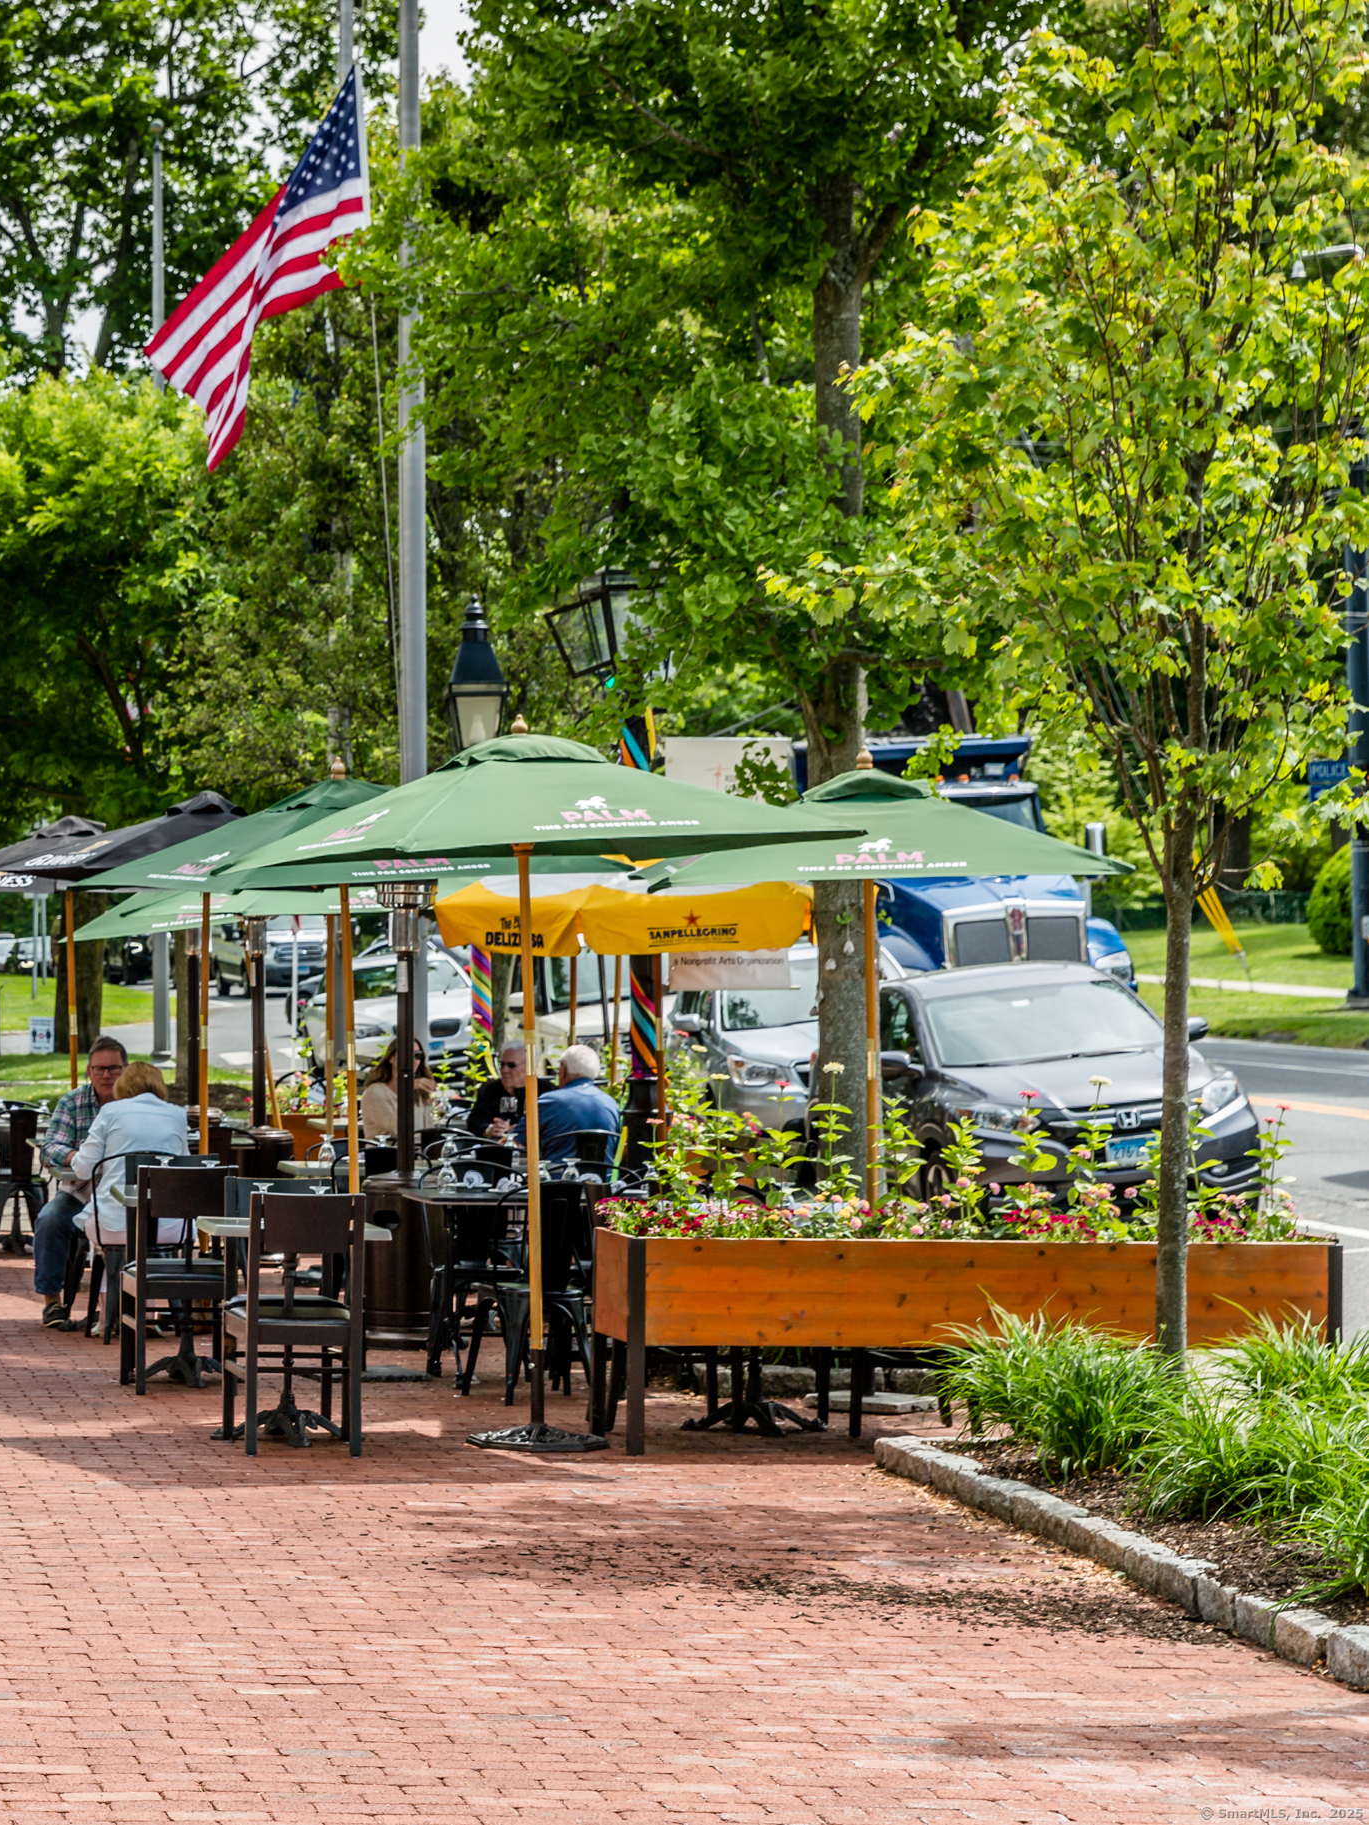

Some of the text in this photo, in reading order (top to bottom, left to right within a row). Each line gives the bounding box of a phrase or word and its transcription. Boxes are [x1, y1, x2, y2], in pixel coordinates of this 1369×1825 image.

[1311, 763, 1347, 777] POLICE
[560, 809, 652, 823] PALM
[589, 820, 657, 828] SOMETHING
[835, 851, 924, 864] PALM
[372, 858, 451, 870] PALM
[398, 866, 455, 875] SOMETHING
[649, 927, 737, 940] SANPELLEGRINO
[680, 956, 717, 967] Nonprofit
[718, 956, 736, 965] Arts
[737, 956, 785, 967] Organization
